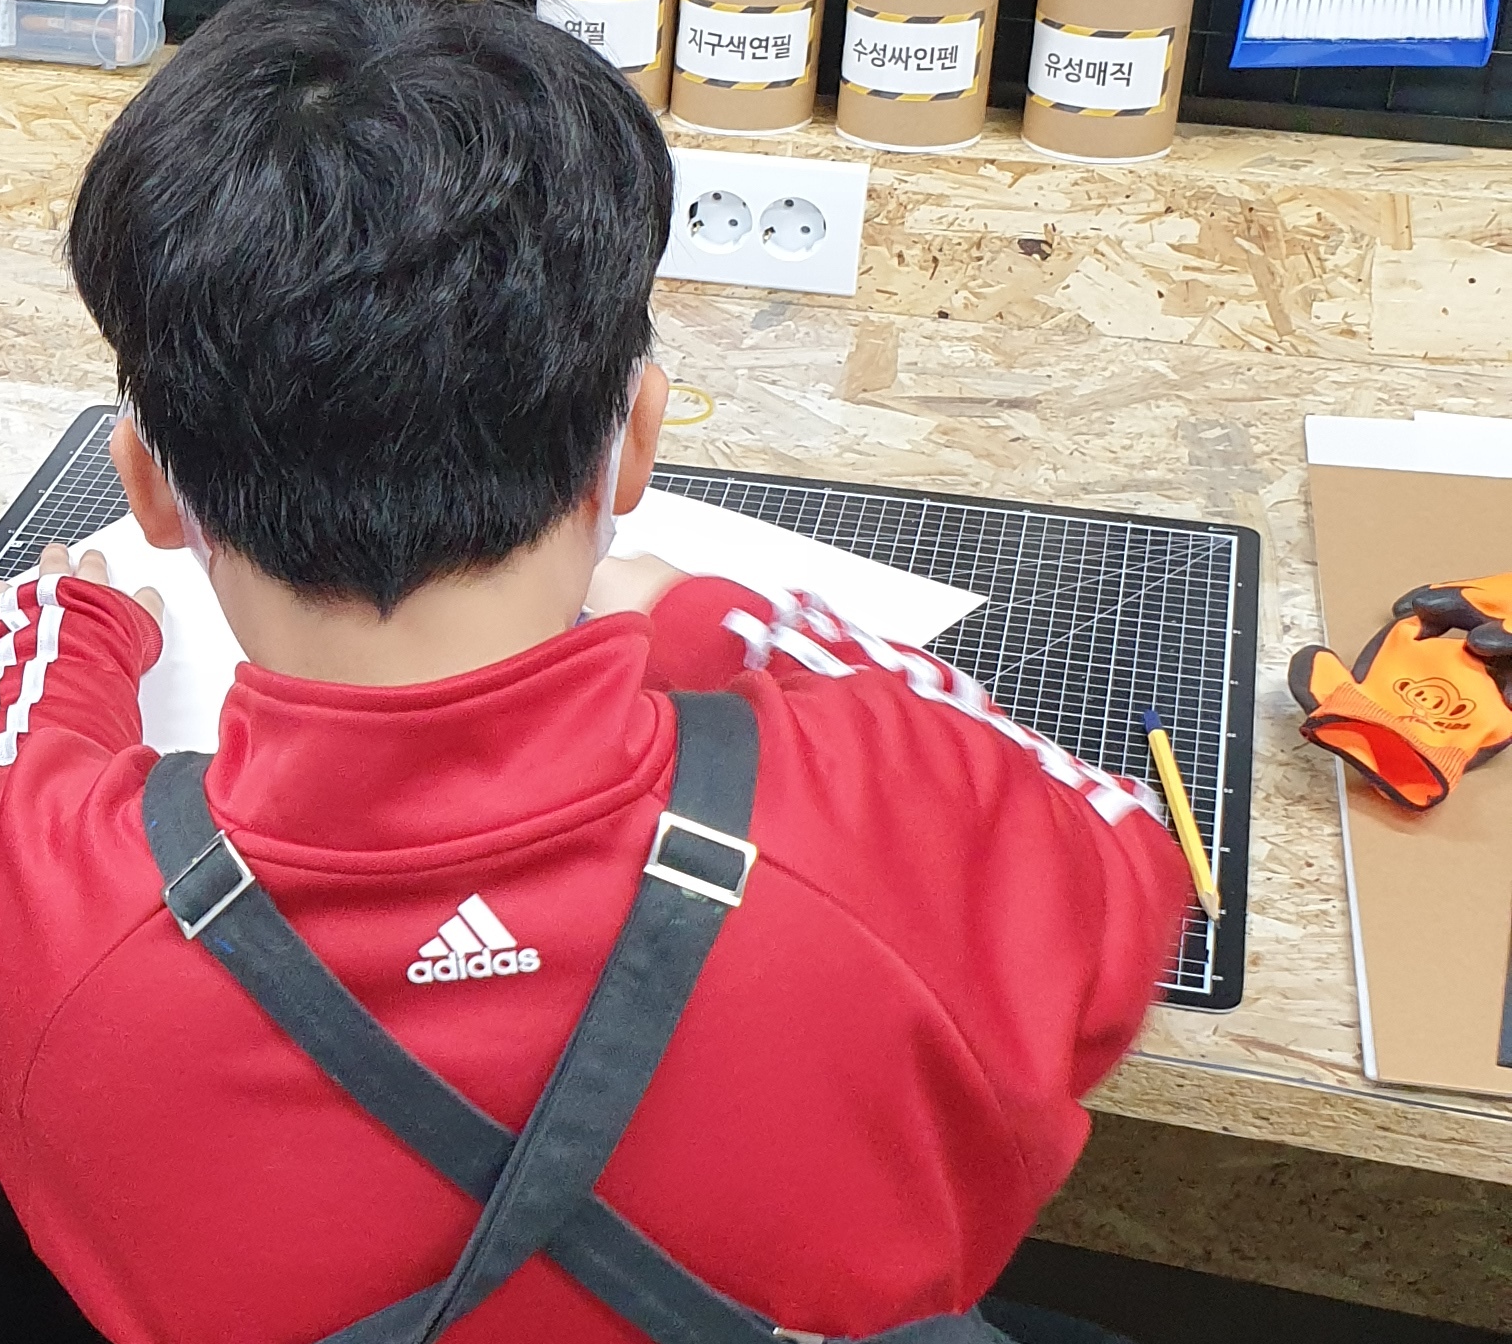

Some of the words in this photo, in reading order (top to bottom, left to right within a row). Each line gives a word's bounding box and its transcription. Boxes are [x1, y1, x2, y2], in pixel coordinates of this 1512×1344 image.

[558, 20, 605, 46] 연필
[688, 26, 793, 60] 지구색연필
[852, 38, 960, 72] 수성싸인펜
[1043, 52, 1134, 87] 유성매직
[406, 946, 541, 984] adidas
